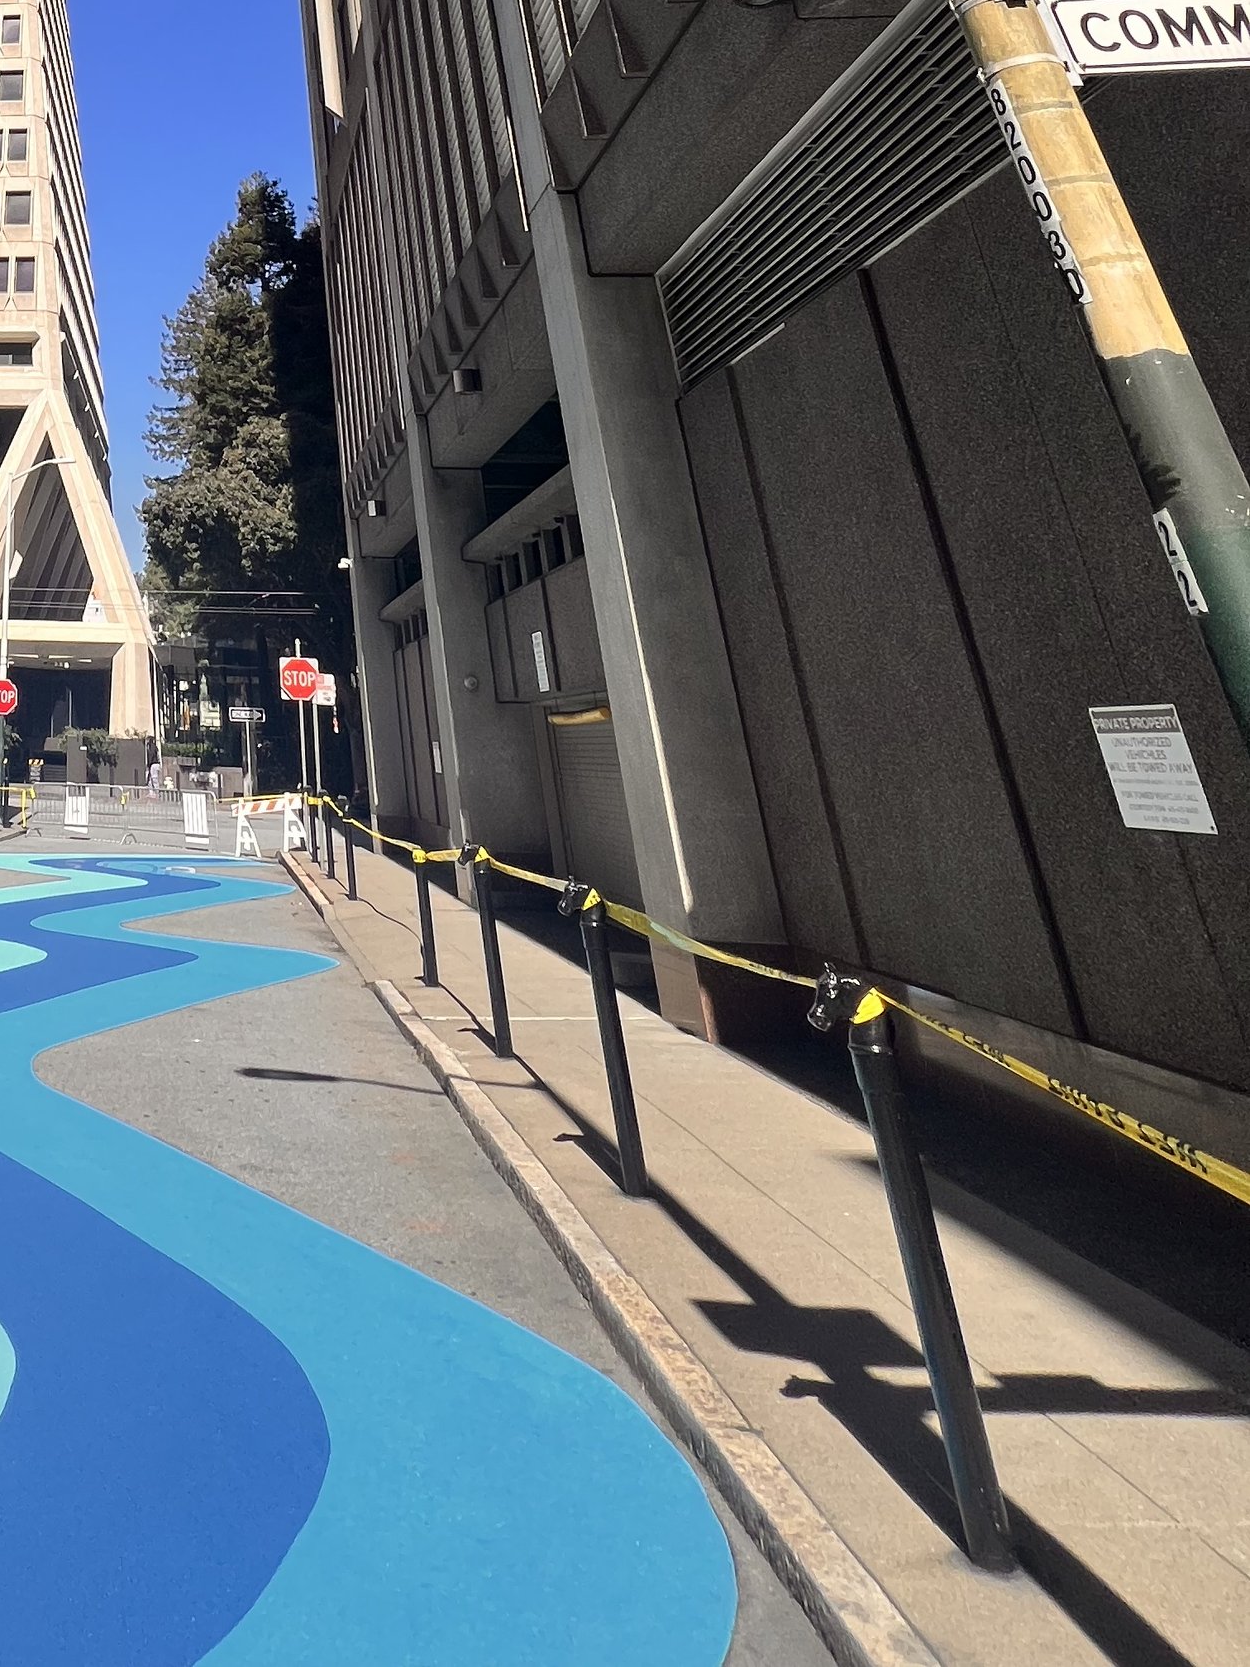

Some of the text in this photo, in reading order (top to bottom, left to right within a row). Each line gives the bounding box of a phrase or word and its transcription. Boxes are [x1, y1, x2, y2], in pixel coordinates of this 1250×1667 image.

[1080, 4, 1250, 52] COMM
[284, 670, 316, 687] STOP
[1094, 715, 1178, 731] PRIVATE PROPERTY
[1112, 737, 1172, 748] UNAUTHORIZED
[1108, 761, 1194, 774] WILL BE TOWED AWAY
